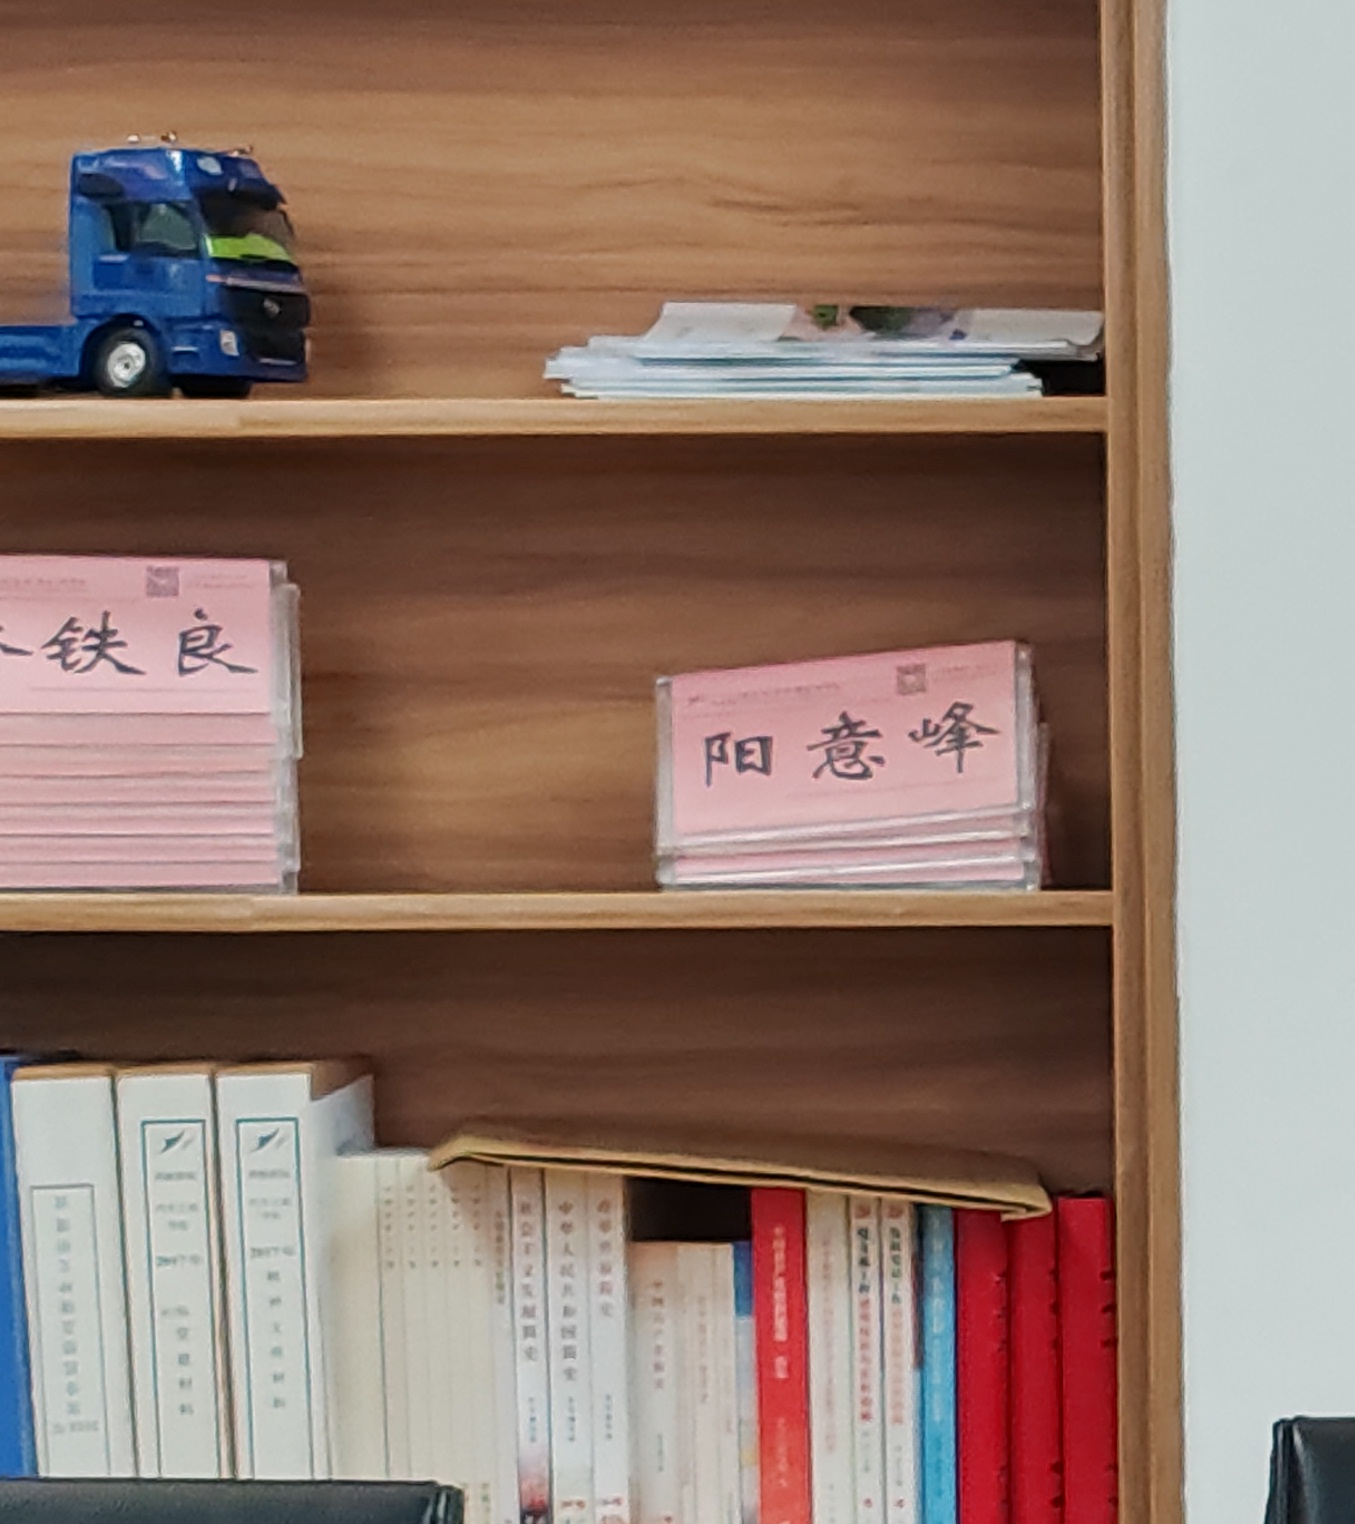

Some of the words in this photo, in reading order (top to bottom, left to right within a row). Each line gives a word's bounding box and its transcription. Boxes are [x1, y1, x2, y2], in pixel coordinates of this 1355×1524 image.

[0, 608, 258, 676] 铁良
[703, 701, 1001, 788] 阳意峰
